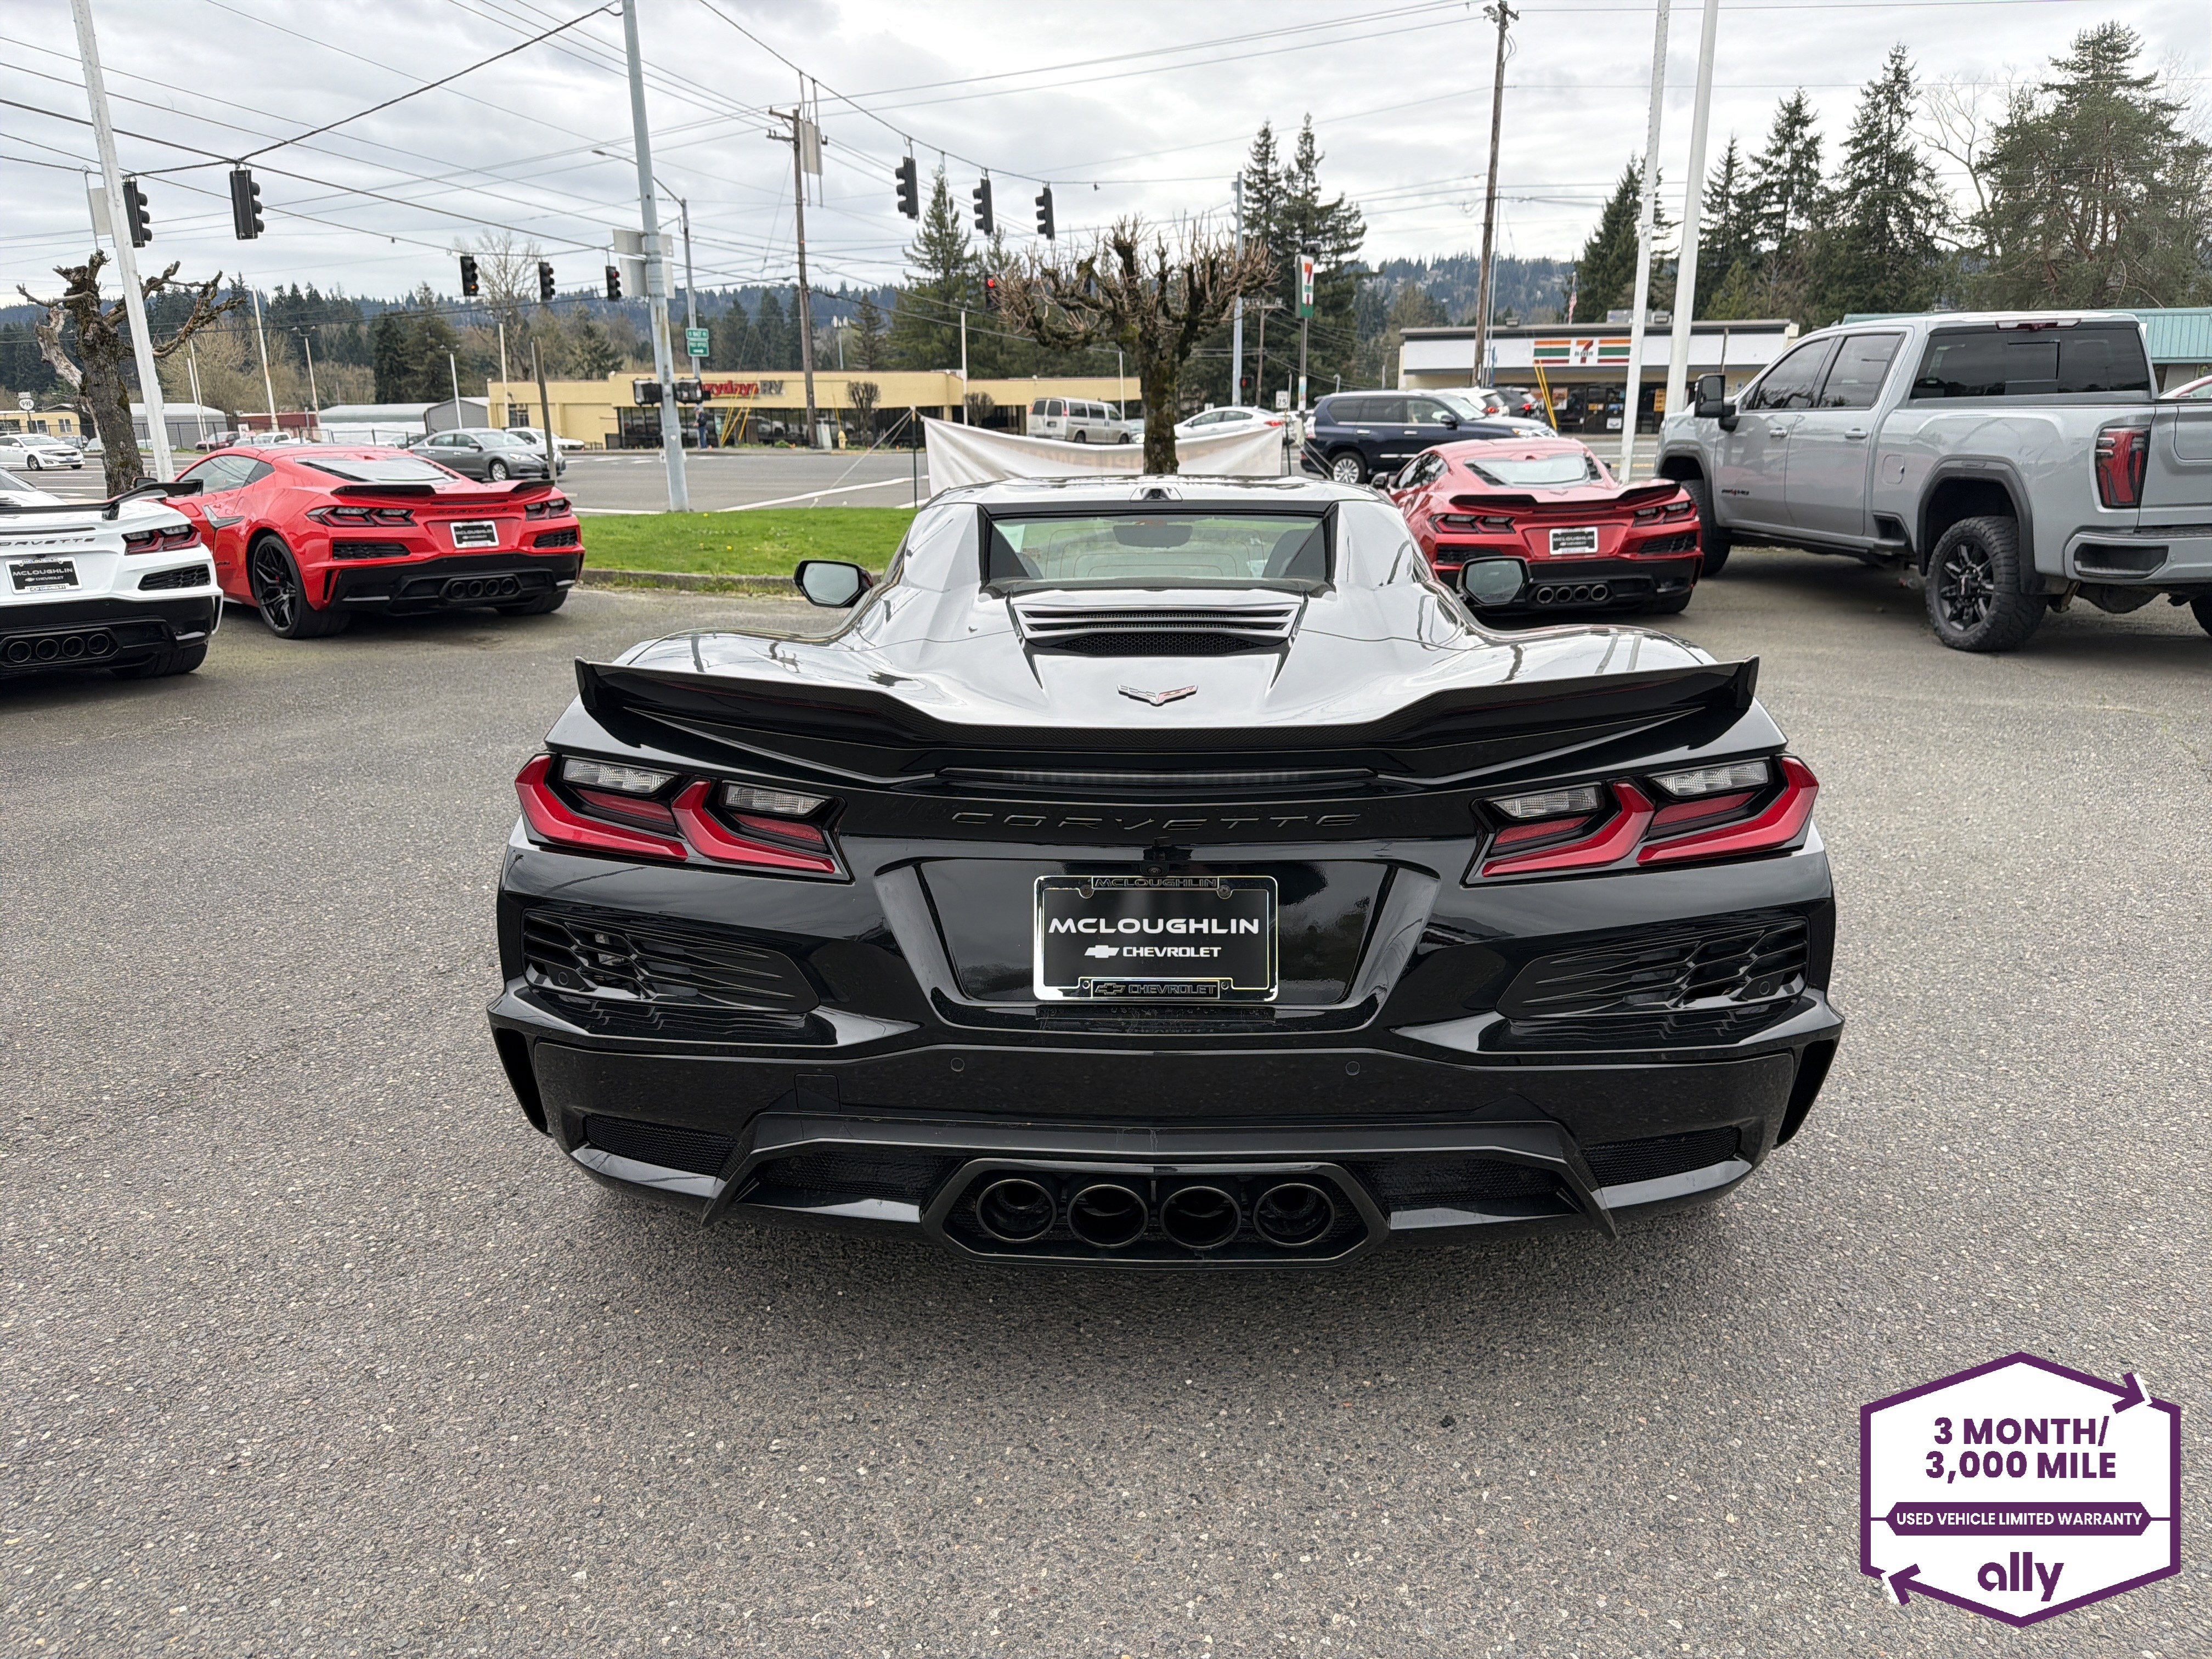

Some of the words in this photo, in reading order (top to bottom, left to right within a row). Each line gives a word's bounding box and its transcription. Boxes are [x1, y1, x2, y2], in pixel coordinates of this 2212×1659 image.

[0, 537, 96, 546] ORVETTE
[13, 567, 73, 577] MCLOUGHLIN
[952, 812, 1361, 830] CORVETTE
[1094, 878, 1217, 888] MCLOUGHLIN
[1048, 918, 1259, 934] MCLOUGHLIN
[1122, 946, 1222, 958] CHEVROLET
[1128, 984, 1217, 995] CHEVROLET
